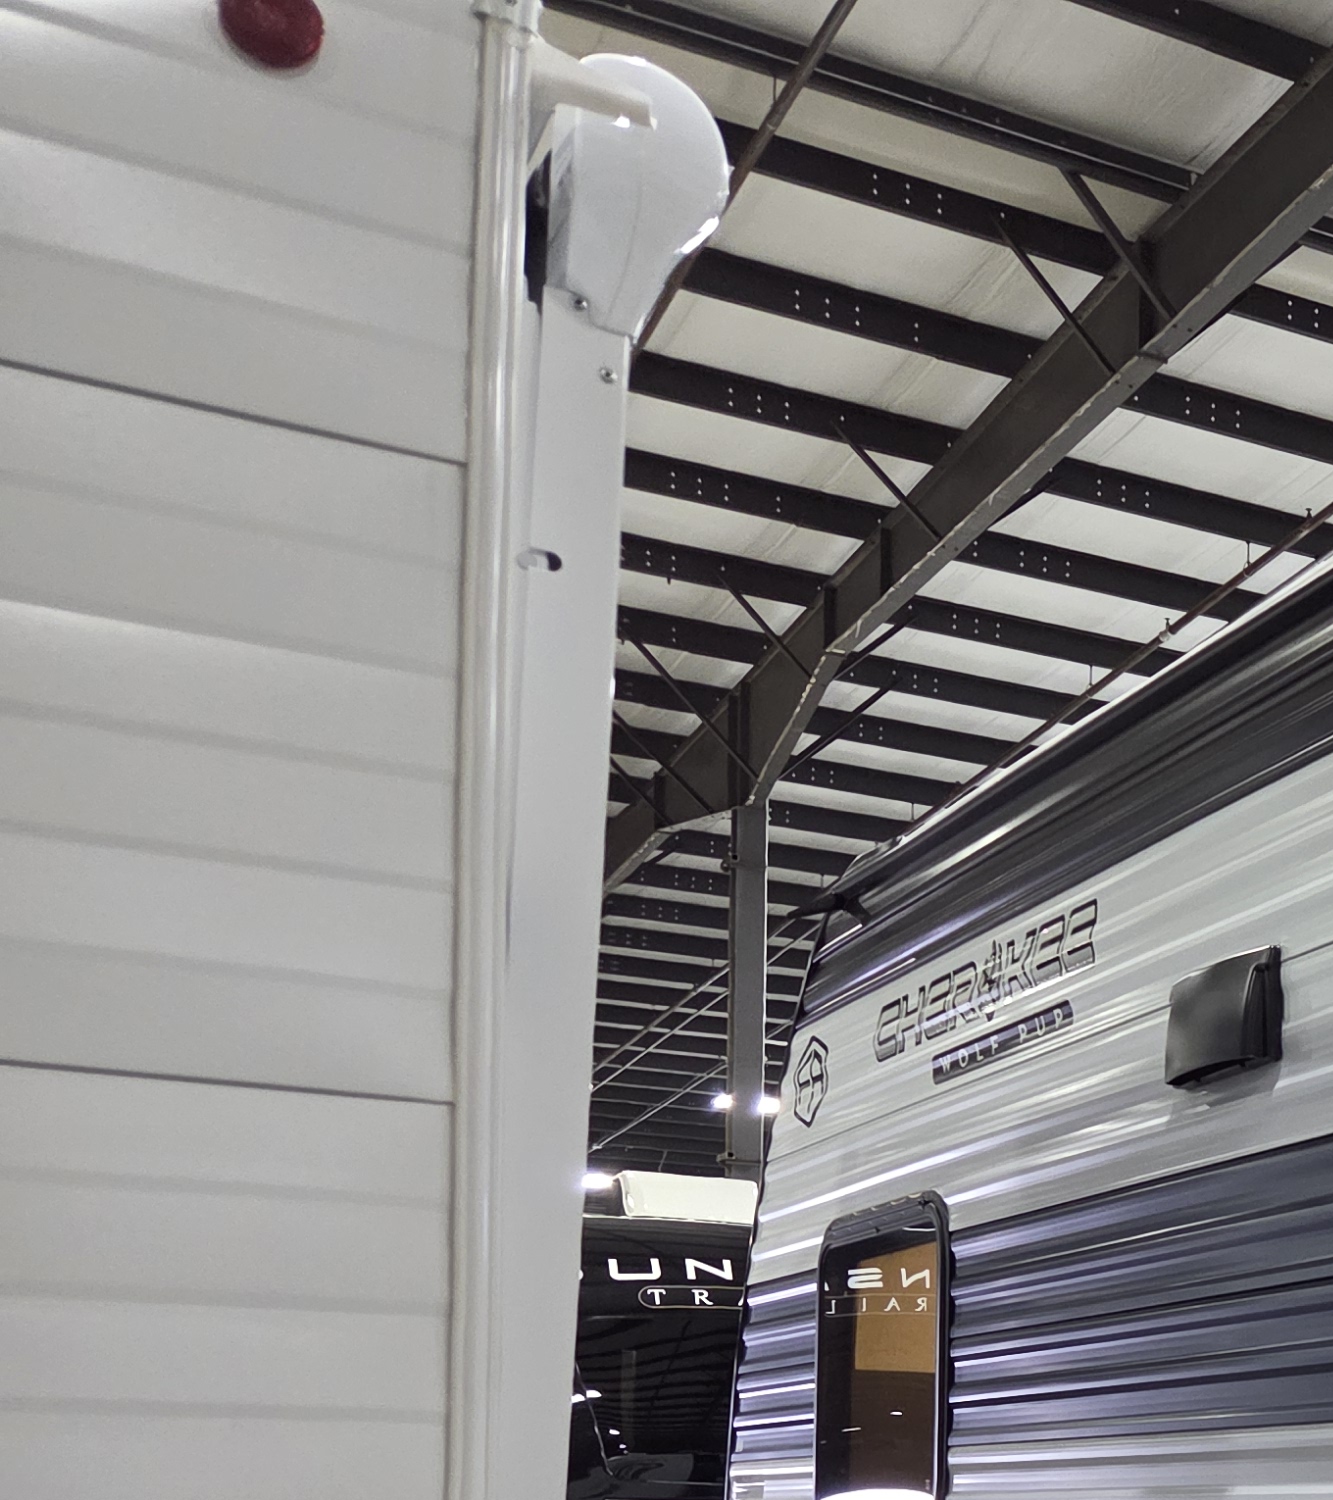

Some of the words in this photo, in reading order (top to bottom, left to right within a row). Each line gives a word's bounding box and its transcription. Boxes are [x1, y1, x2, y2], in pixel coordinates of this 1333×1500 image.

[938, 1035, 999, 1074] WOLF
[1017, 1008, 1064, 1043] PUP
[577, 1257, 734, 1281] UN
